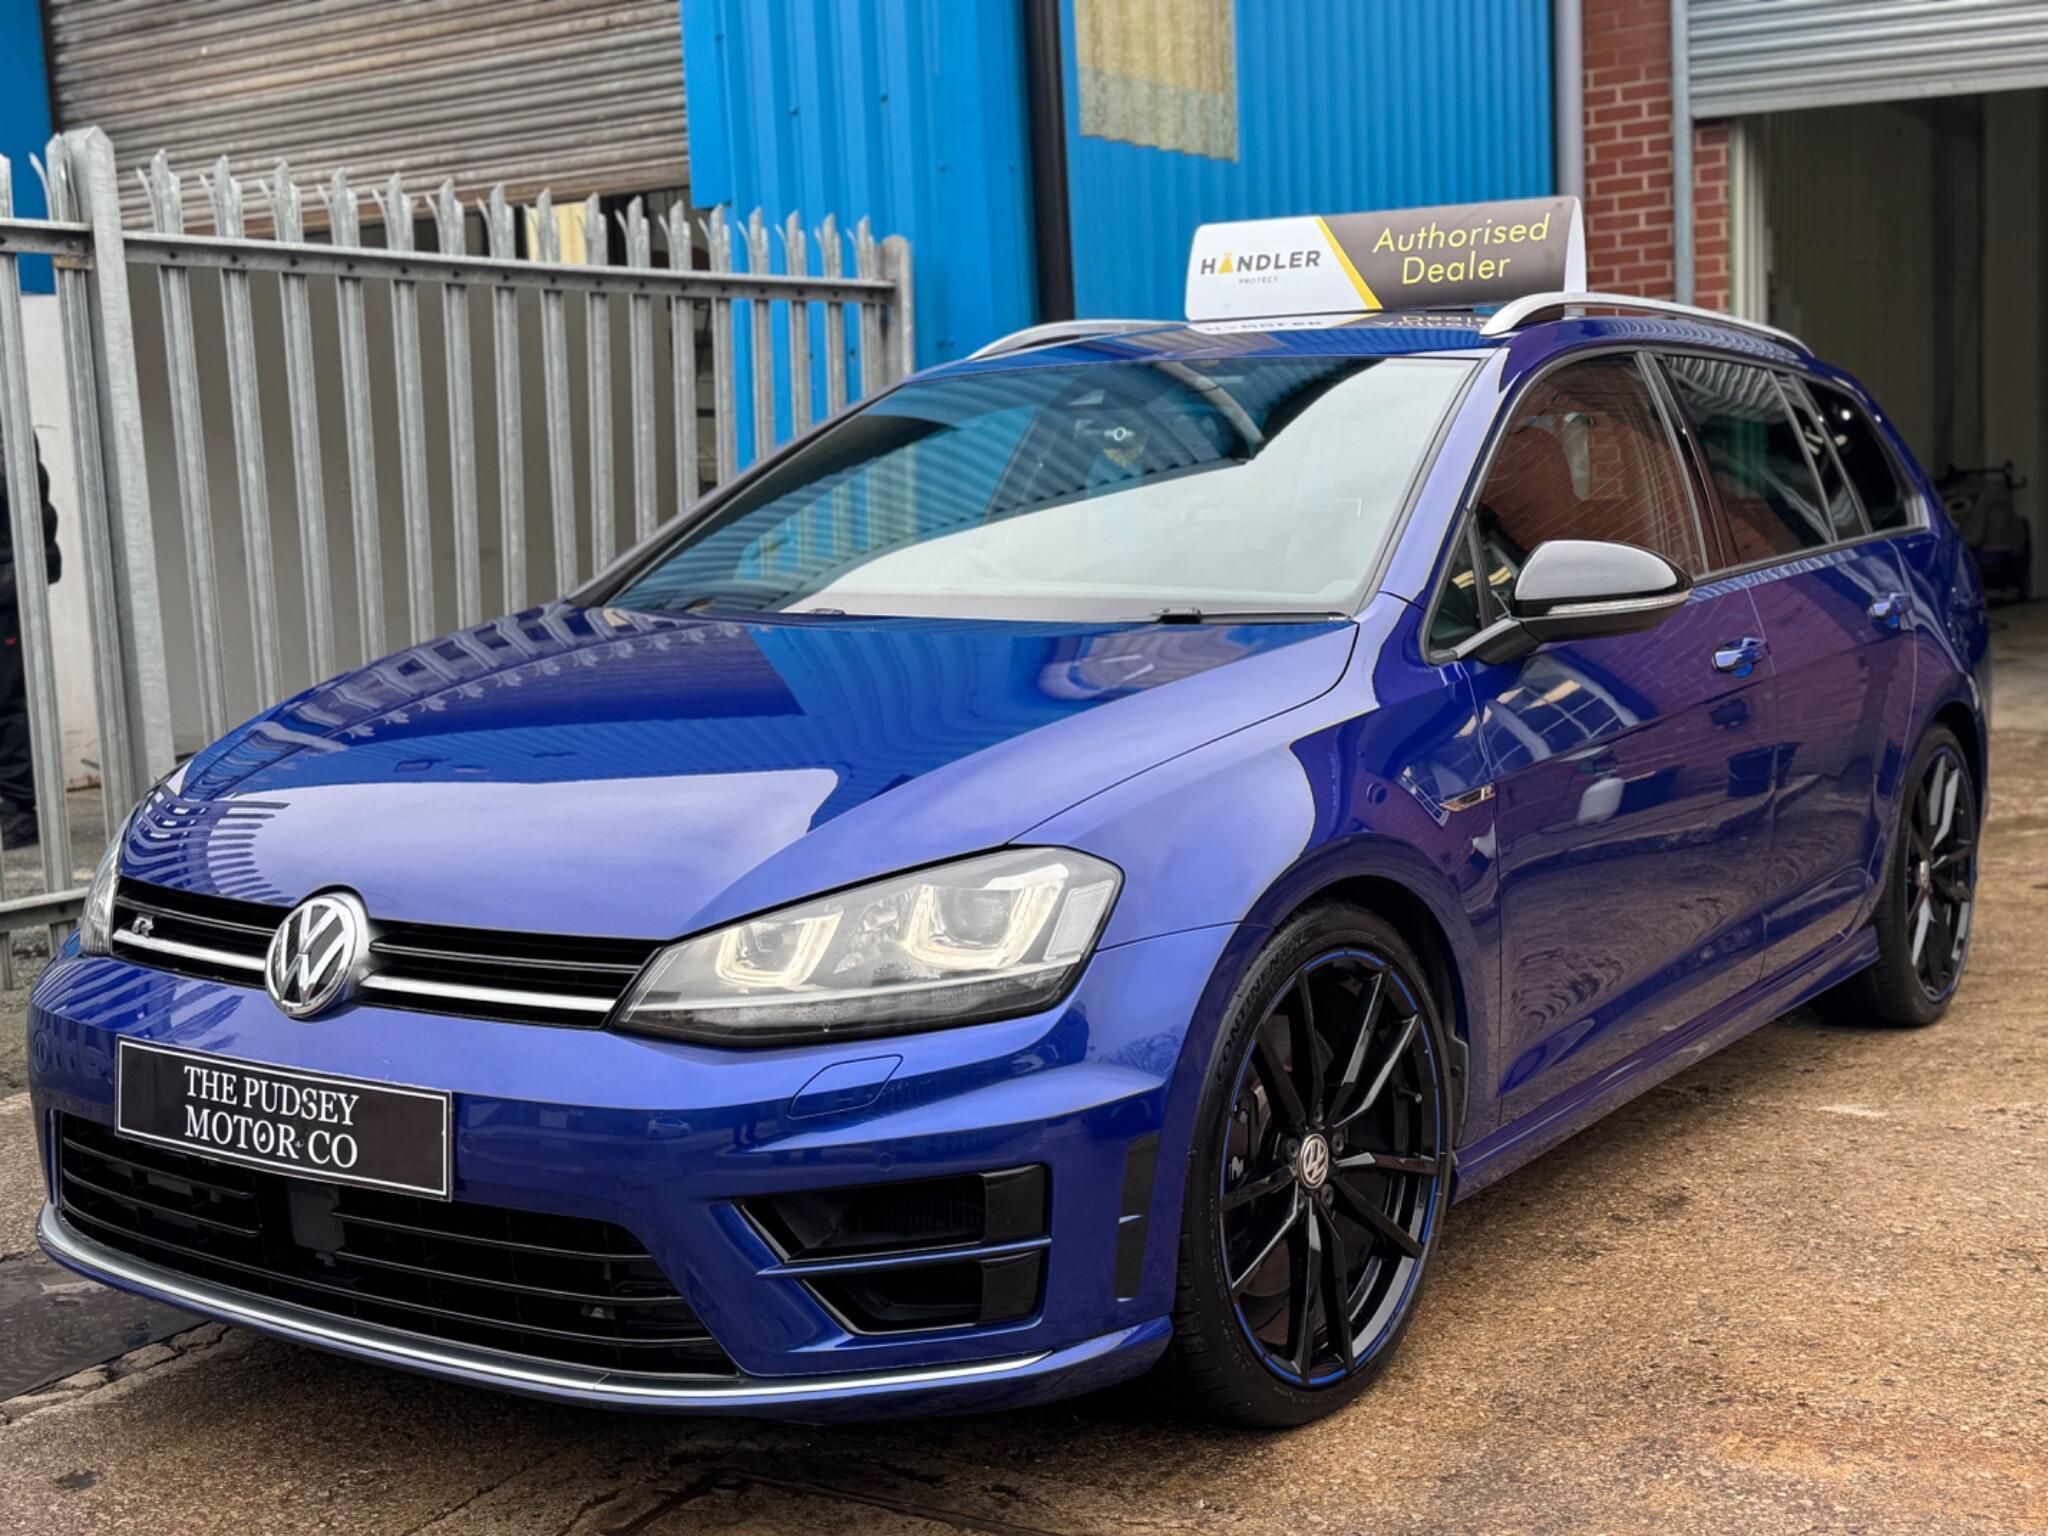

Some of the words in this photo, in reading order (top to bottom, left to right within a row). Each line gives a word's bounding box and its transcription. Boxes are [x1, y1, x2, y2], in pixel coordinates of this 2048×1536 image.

[1372, 213, 1551, 254] Authorised
[1238, 276, 1278, 286] PROTECT
[1402, 251, 1511, 285] Dealer
[184, 1065, 237, 1106] THE
[244, 1076, 359, 1127] PUDSEY
[184, 1105, 300, 1160] MOTOR
[308, 1130, 358, 1169] CO
